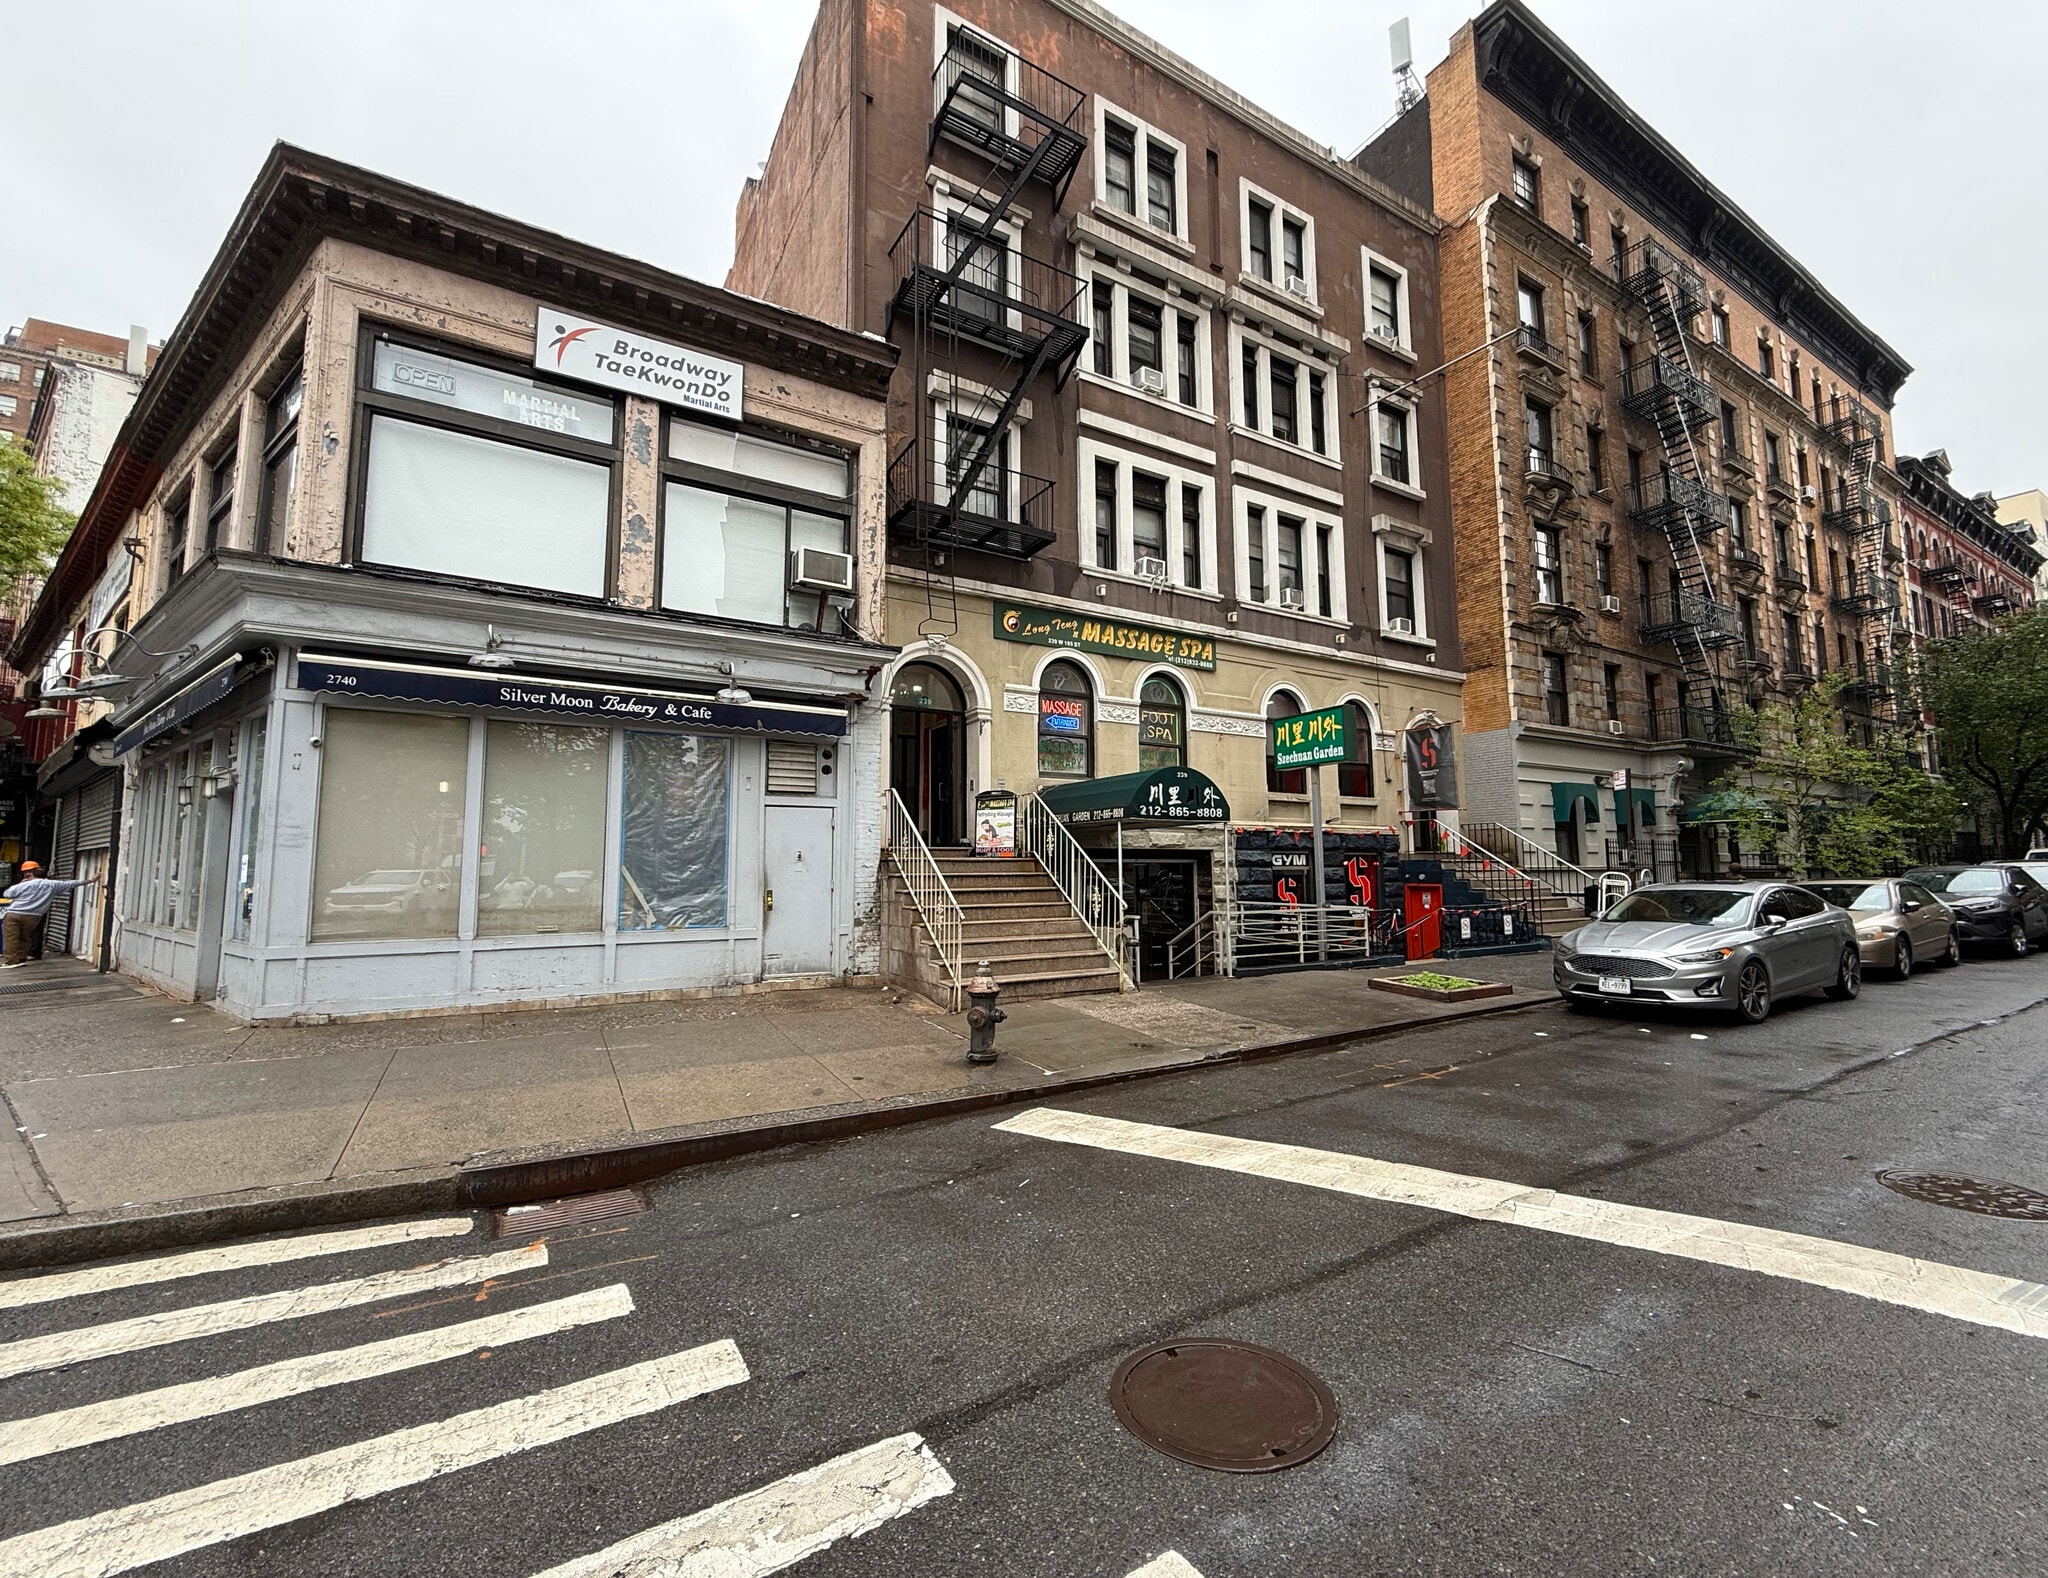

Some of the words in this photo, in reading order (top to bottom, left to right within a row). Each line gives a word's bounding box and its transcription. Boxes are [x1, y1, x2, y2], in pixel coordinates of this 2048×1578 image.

[613, 339, 732, 386] Broadway
[396, 364, 454, 392] OPEN
[594, 353, 731, 403] TaeKwonDo
[503, 389, 581, 421] MARTIAL
[683, 394, 712, 410] Martial
[713, 402, 731, 414] Arts
[519, 407, 565, 431] ARTS
[1022, 623, 1051, 636] Long
[1052, 618, 1079, 631] Teng
[1081, 621, 1177, 656] MASSAGE
[1179, 638, 1213, 660] SPA
[326, 674, 357, 686] 2740
[500, 687, 546, 704] Silver
[550, 692, 593, 708] Moon
[599, 695, 658, 719] Bakery
[665, 703, 678, 716] &
[681, 705, 712, 719] Cafe
[919, 697, 932, 705] 239
[1042, 699, 1082, 717] MASSAGE
[1141, 710, 1175, 725] FOOT
[1147, 725, 1172, 742] SPA
[1277, 750, 1313, 765] Szechuan
[1313, 744, 1344, 760] Garden
[1072, 810, 1091, 822] GARDEN
[1139, 805, 1223, 818] 212-865-8808
[1272, 854, 1307, 866] GYM
